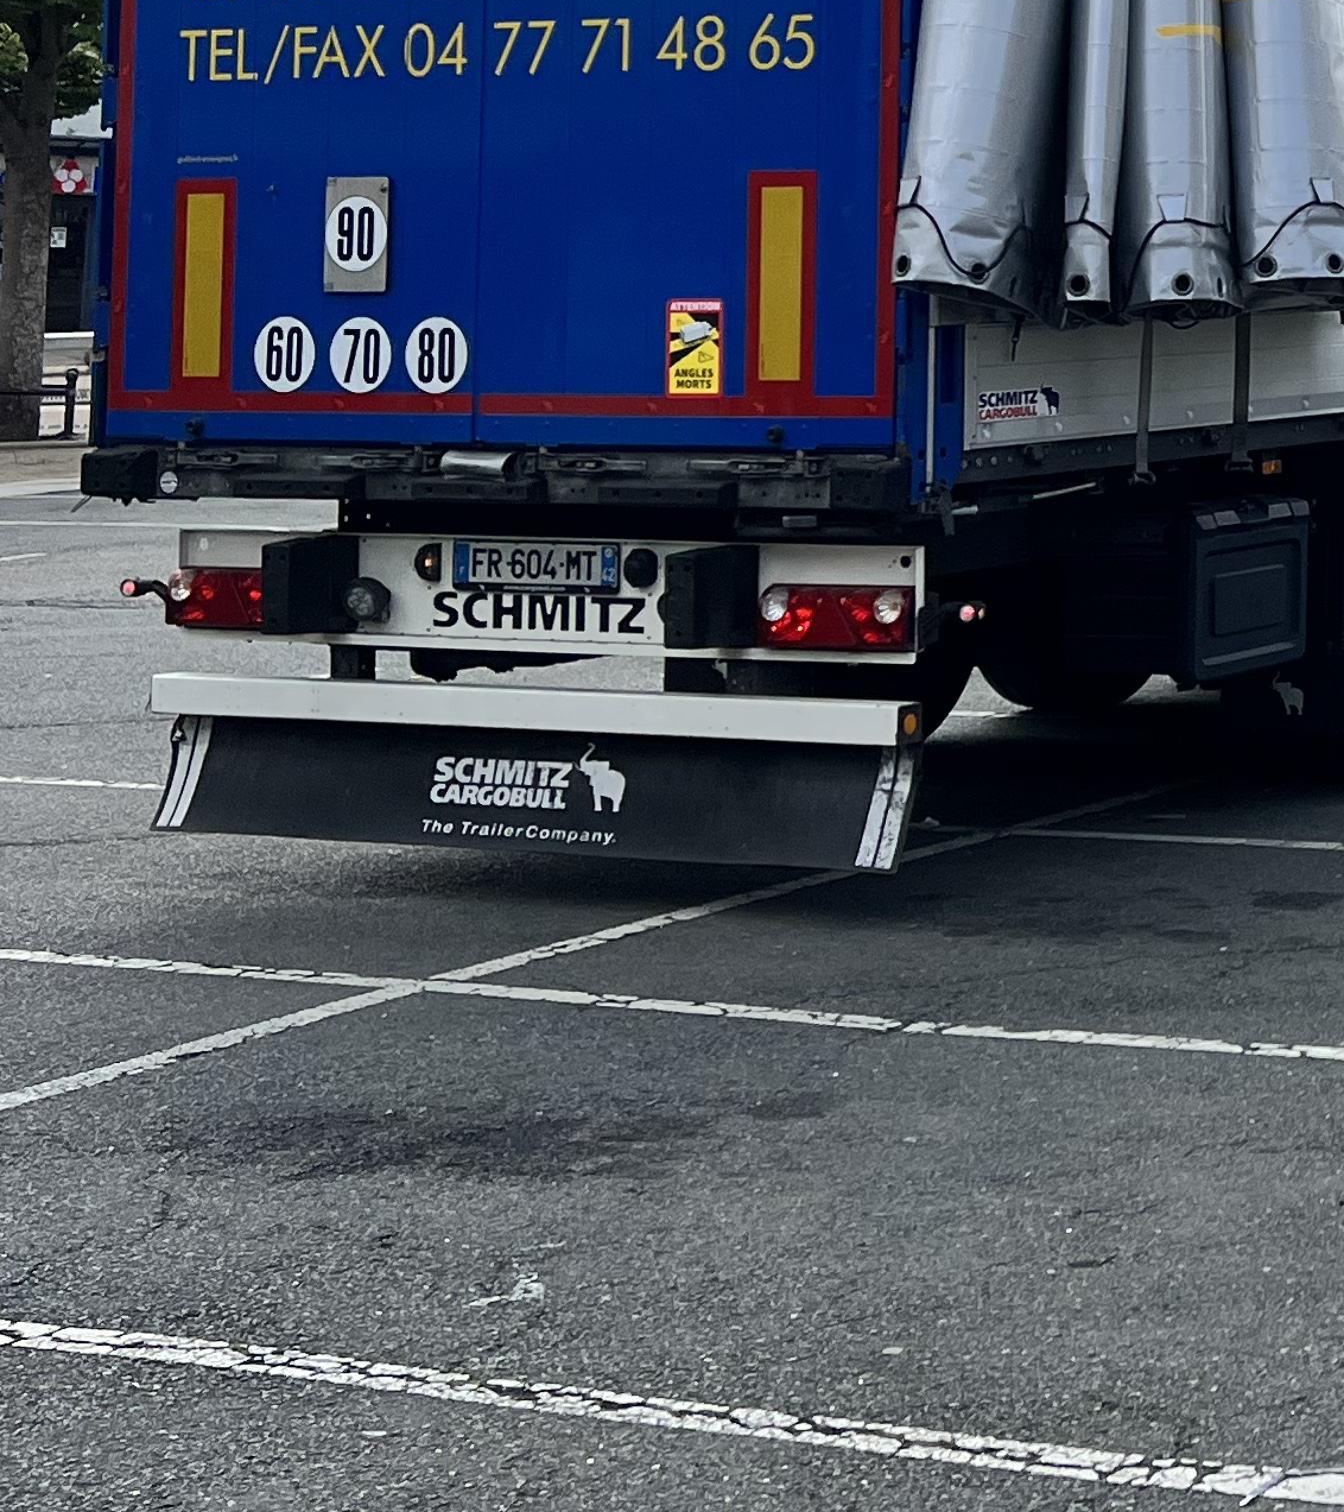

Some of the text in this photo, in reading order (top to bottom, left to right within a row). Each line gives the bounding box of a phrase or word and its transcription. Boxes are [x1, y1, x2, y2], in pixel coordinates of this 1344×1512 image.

[180, 13, 816, 82] TEL/FAX 04 77 71 48 65
[337, 206, 375, 262] 90
[265, 325, 303, 382] 60
[343, 327, 381, 385] 70
[417, 327, 456, 384] 80
[674, 368, 714, 379] ANGLES
[675, 379, 712, 389] MORTS
[978, 390, 1038, 408] SCHMITZ
[601, 567, 617, 582] 42
[432, 591, 647, 635] SCHMITZ
[432, 756, 574, 788] SCHMITZ
[429, 783, 567, 810] CARGOBULL
[422, 818, 454, 834] The
